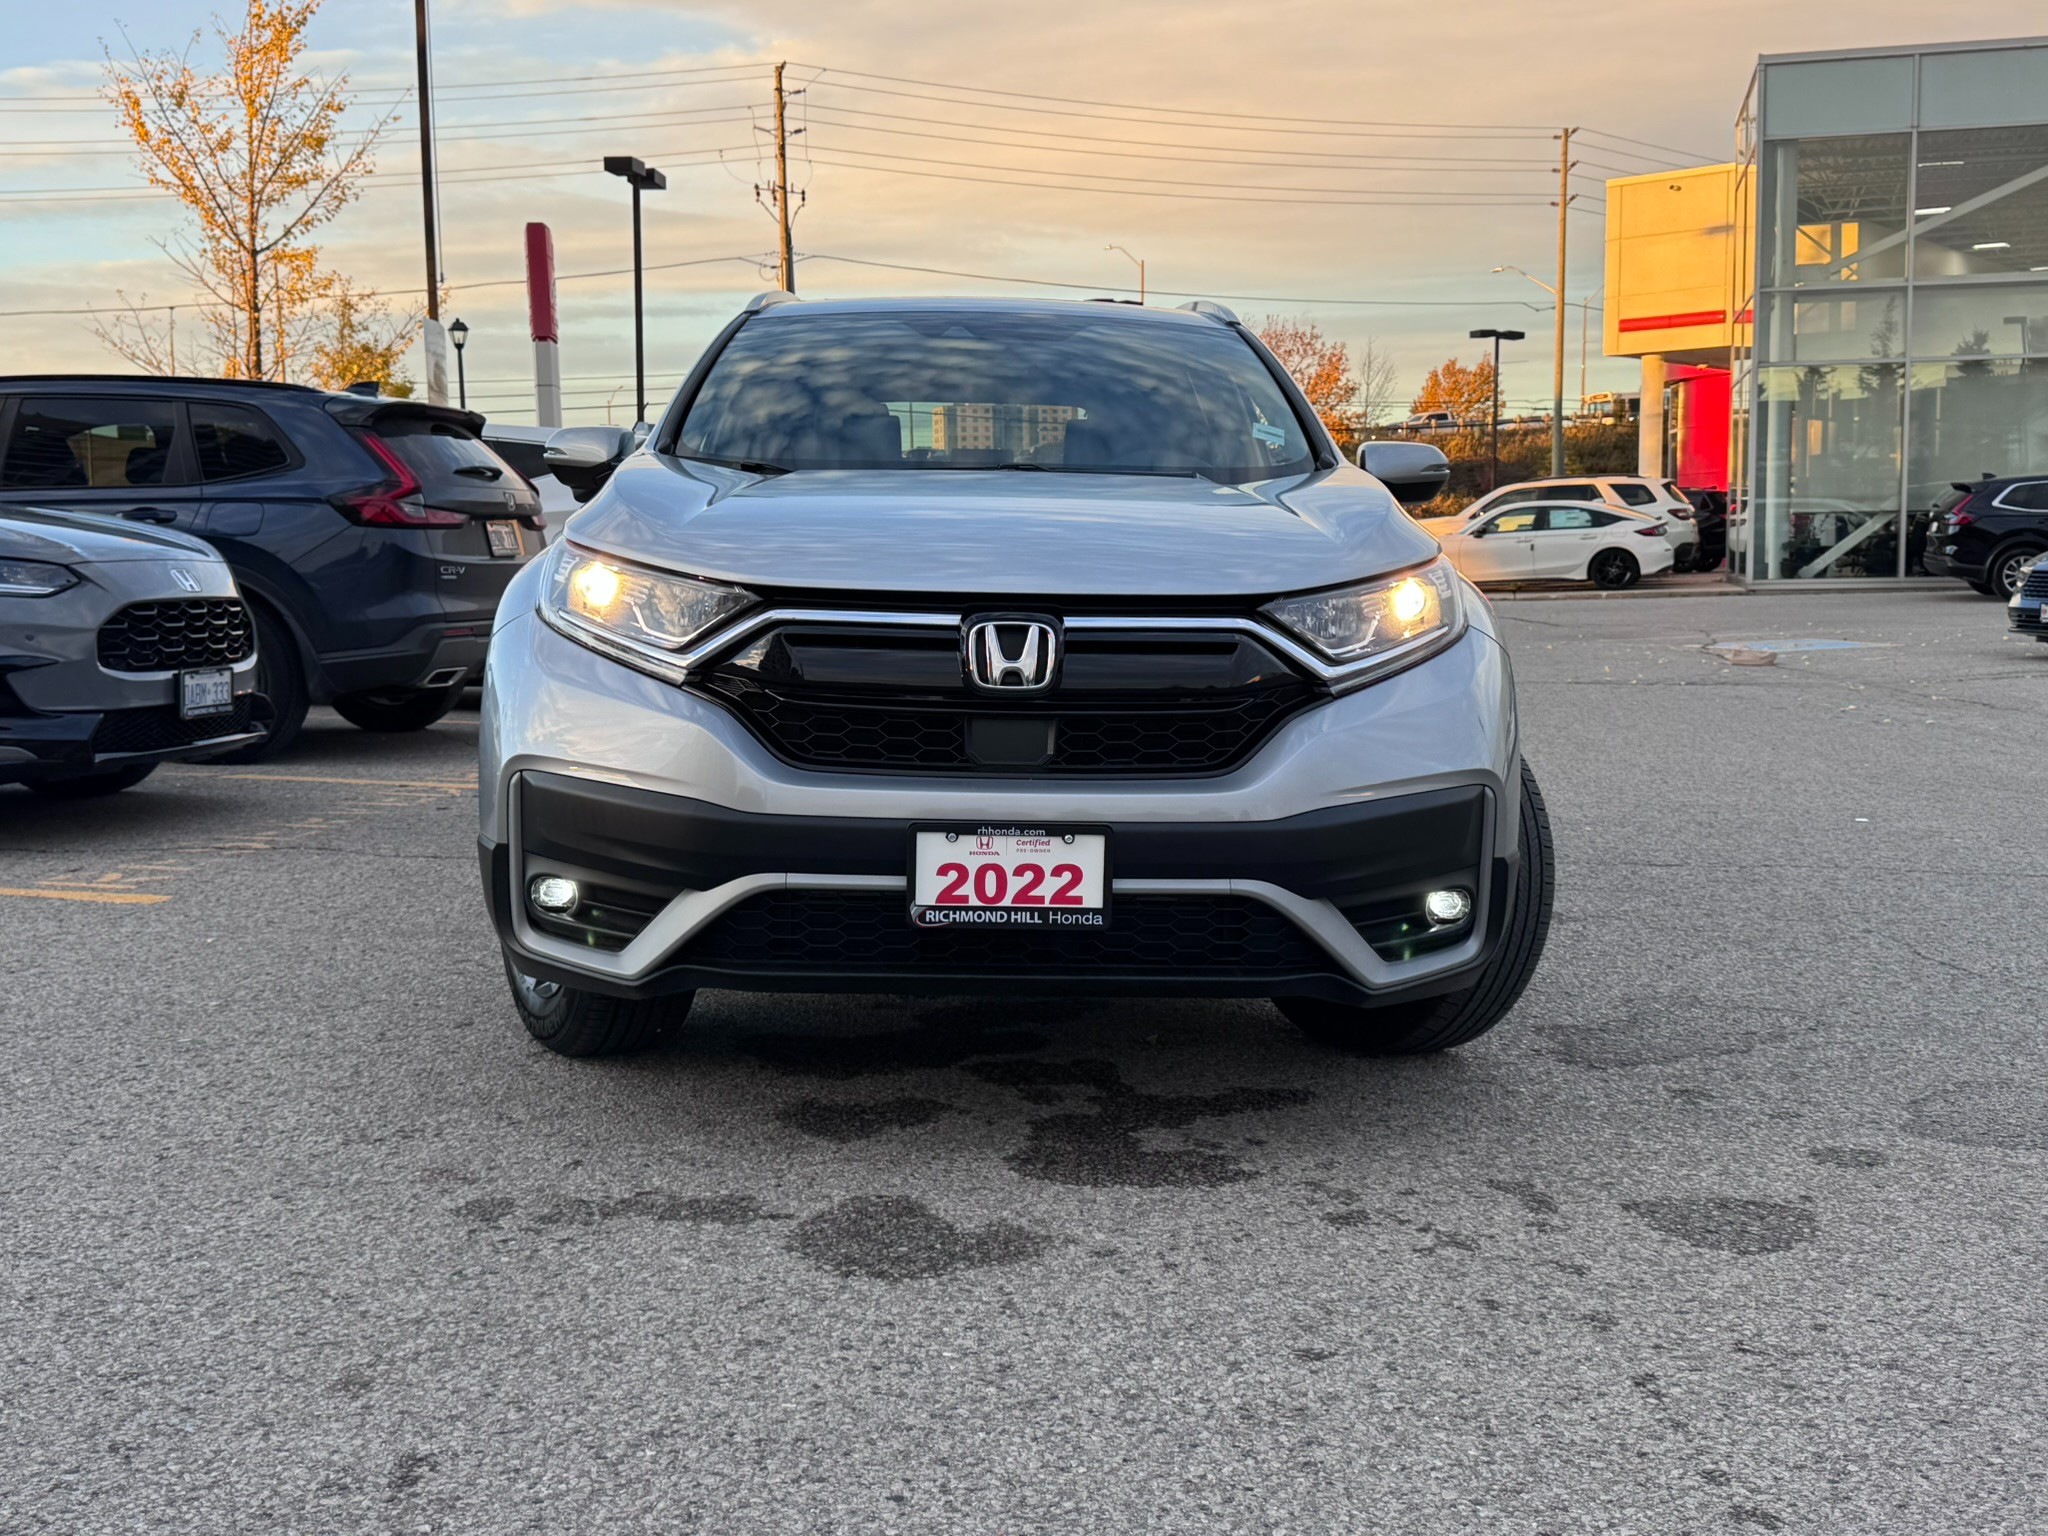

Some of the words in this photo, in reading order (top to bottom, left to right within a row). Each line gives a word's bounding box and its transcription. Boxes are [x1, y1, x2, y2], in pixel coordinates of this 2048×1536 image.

[440, 565, 466, 575] CR-V
[977, 826, 1046, 836] rhhonda.com
[1016, 838, 1051, 848] Certified
[935, 862, 1084, 906] 2022
[925, 910, 1008, 923] RICHMOND
[1010, 911, 1042, 923] HILL
[1049, 911, 1104, 925] Honda
